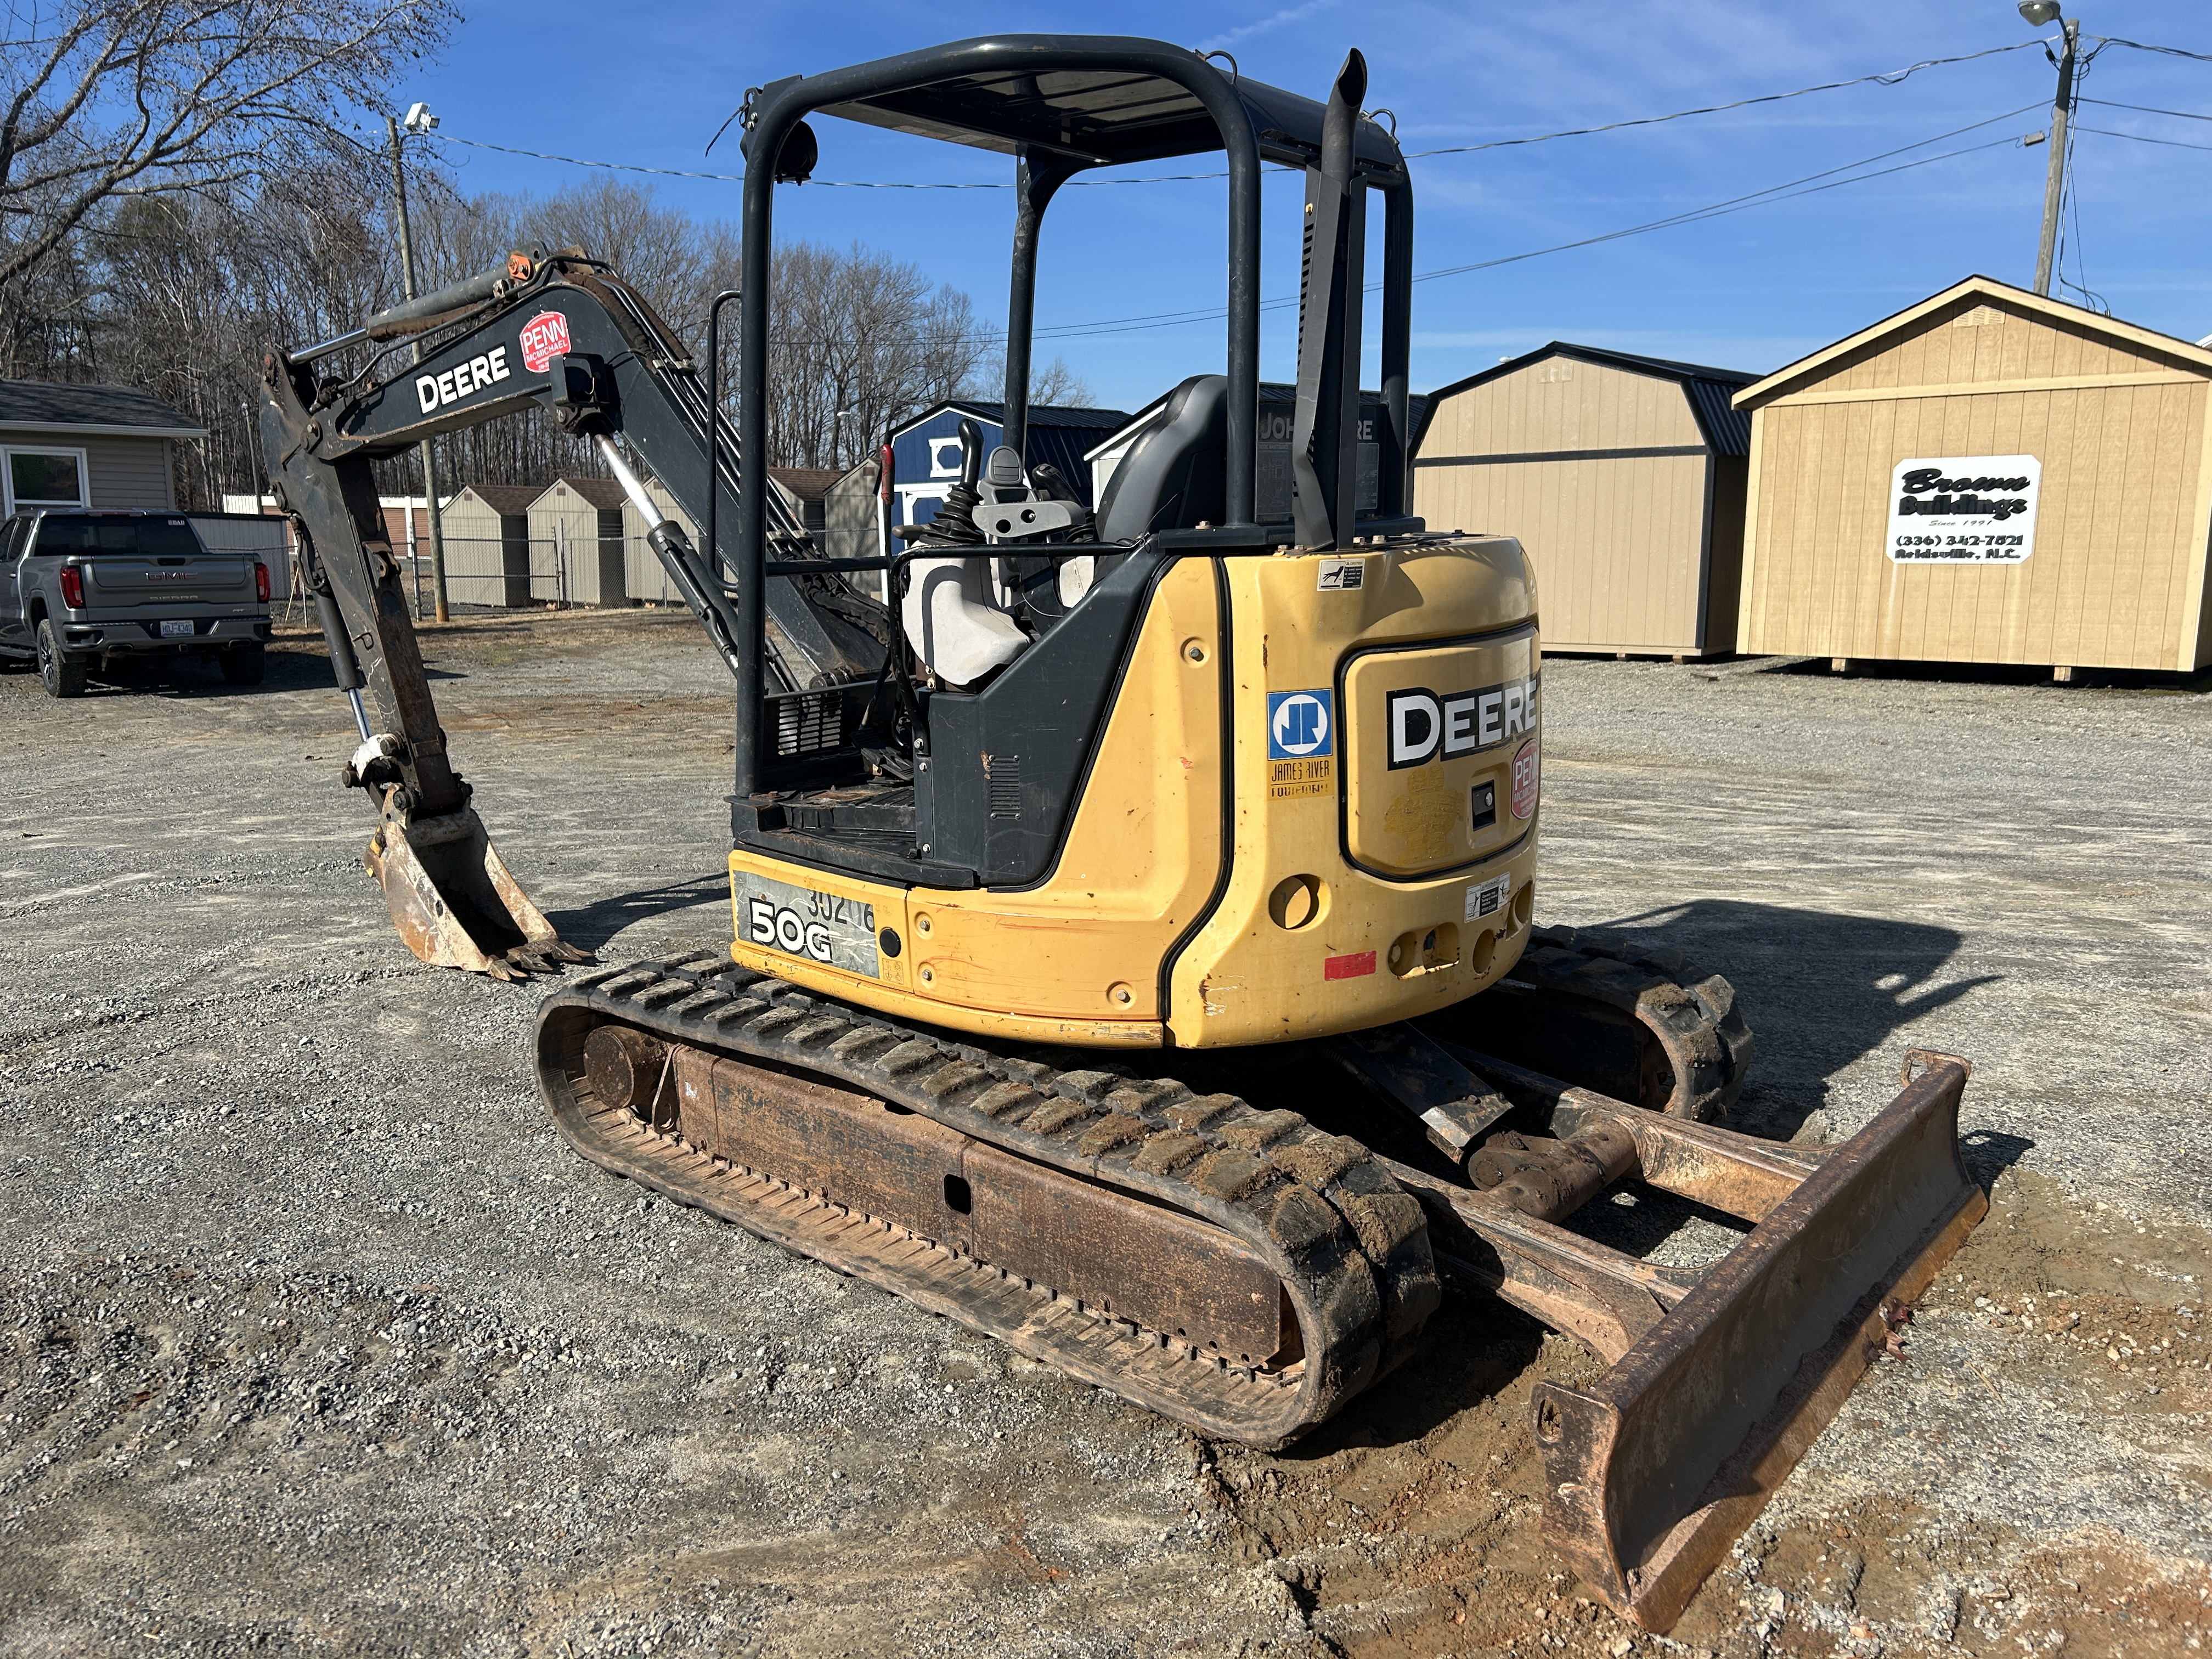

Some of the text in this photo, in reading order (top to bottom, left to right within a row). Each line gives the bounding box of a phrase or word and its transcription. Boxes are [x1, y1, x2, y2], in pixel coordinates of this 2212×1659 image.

[522, 317, 566, 354] PENN
[527, 340, 568, 363] MCMICHAEL
[415, 346, 510, 414] DEERE
[1261, 412, 1294, 439] JOH
[1901, 468, 2030, 494] Brown
[1898, 494, 2028, 521] Buildings
[1896, 535, 1942, 547] (336)
[1985, 548, 2021, 559] N.C.
[145, 572, 198, 580] GMC
[1392, 679, 1537, 763] DEERE
[1271, 760, 1329, 782] JAMES RIVER
[750, 898, 833, 963] 50G
